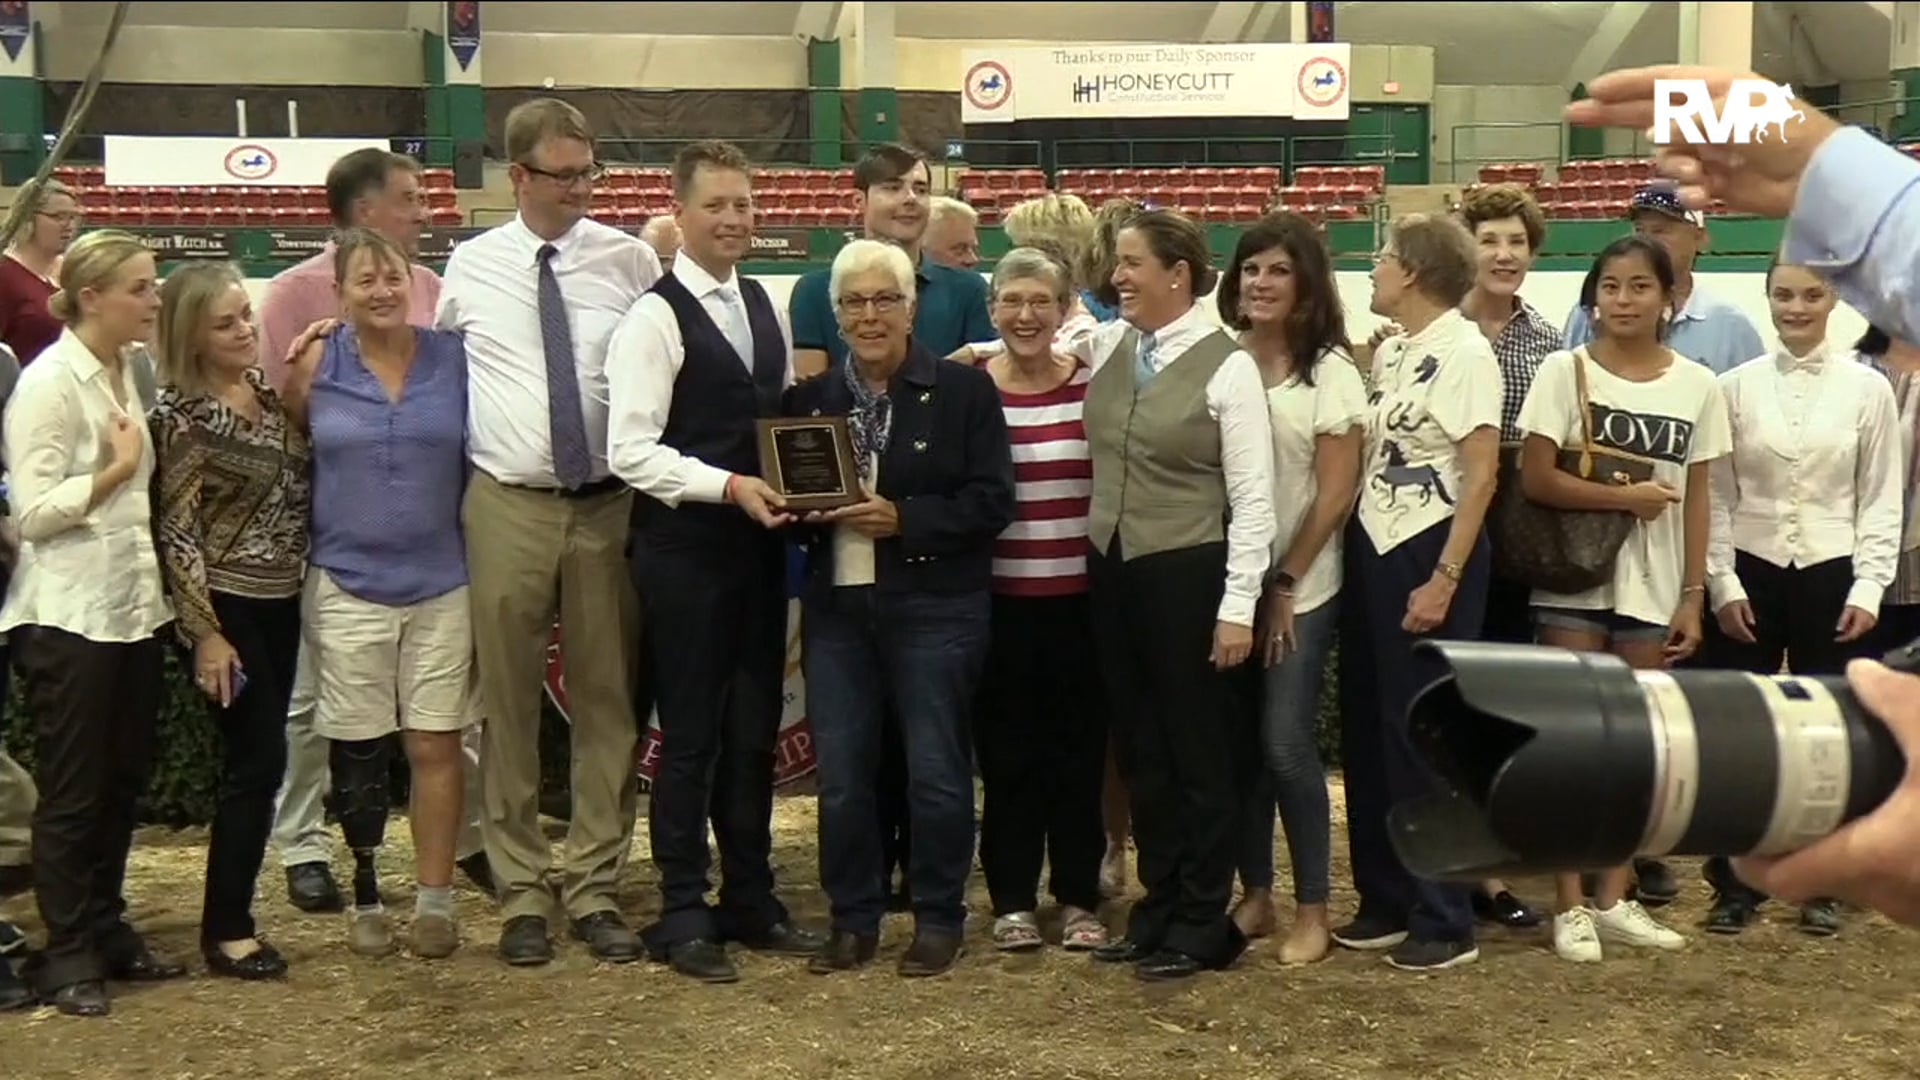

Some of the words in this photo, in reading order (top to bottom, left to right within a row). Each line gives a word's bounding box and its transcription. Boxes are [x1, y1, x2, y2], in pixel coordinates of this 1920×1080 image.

[1053, 50, 1105, 64] Thanks
[1155, 49, 1191, 65] Daily
[1195, 48, 1255, 65] Sponsor
[1103, 73, 1234, 91] HONEYCUTT
[406, 142, 420, 154] 27
